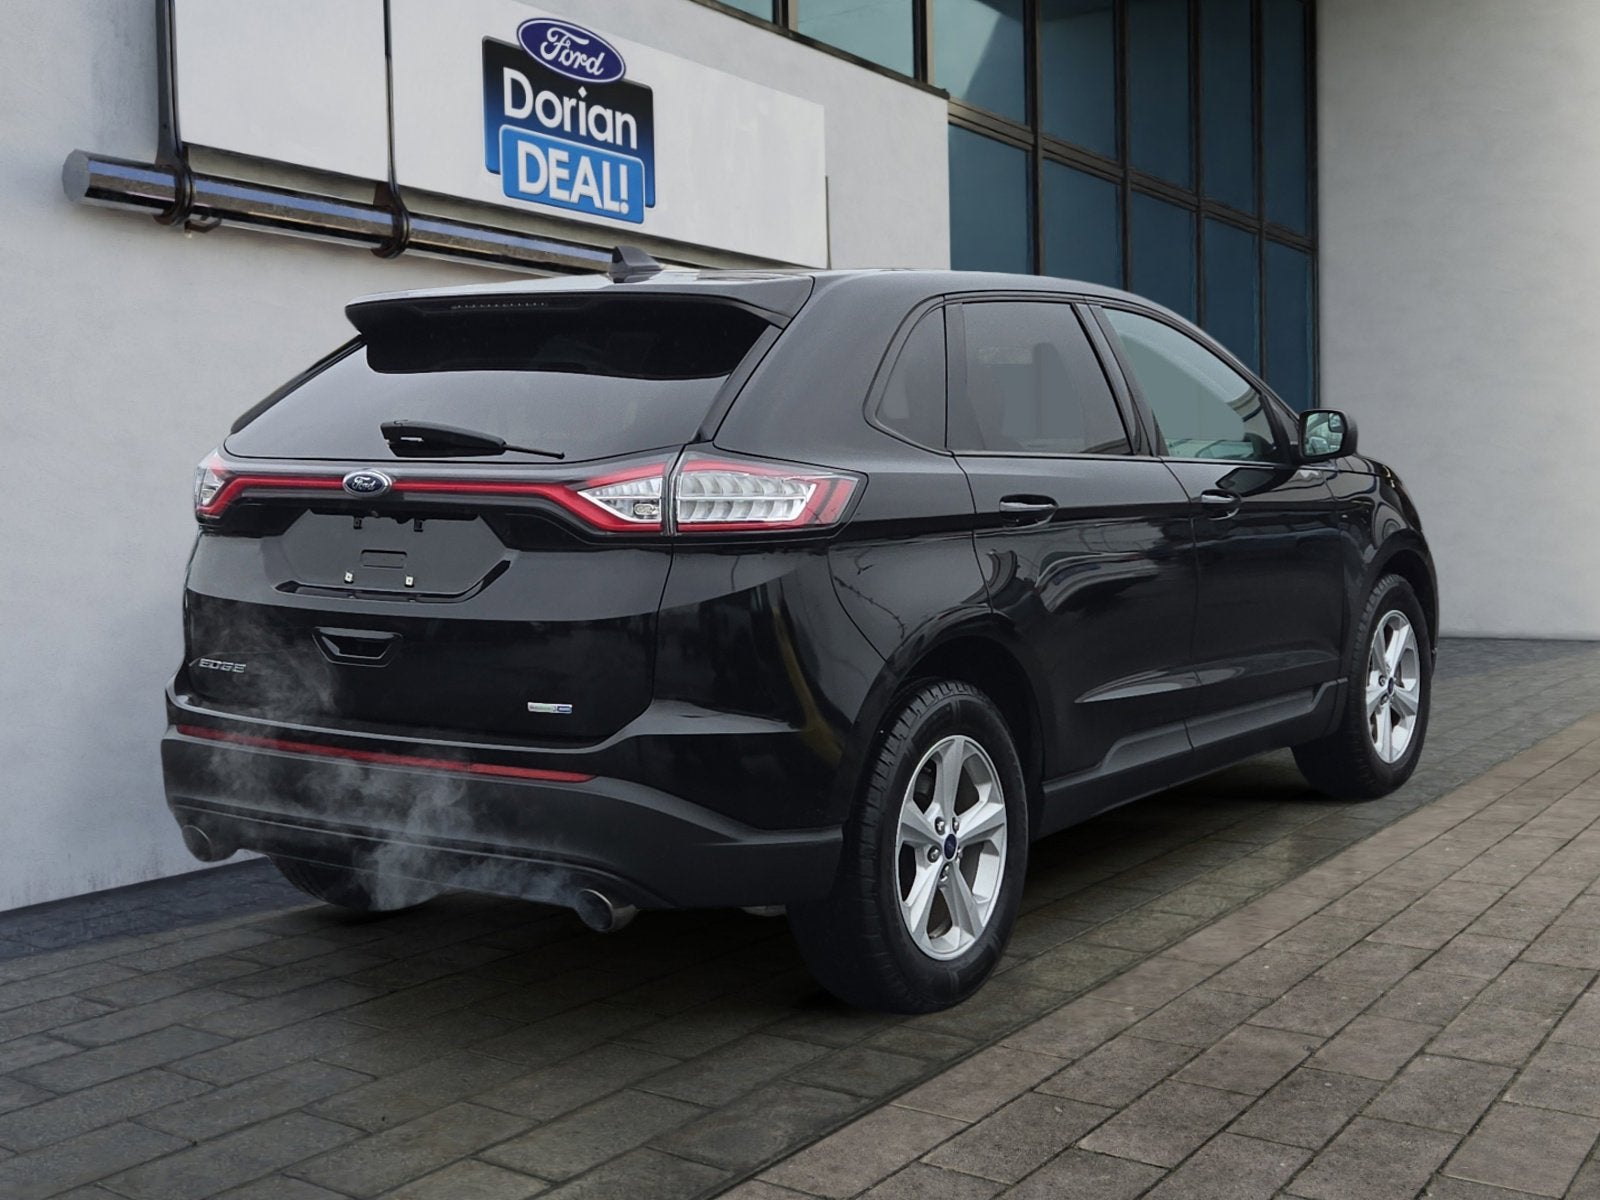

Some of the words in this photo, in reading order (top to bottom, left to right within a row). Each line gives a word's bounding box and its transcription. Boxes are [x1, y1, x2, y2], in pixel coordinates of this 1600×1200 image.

[540, 27, 605, 76] Ford
[503, 66, 637, 150] Dorian
[517, 139, 630, 214] DEAL!
[352, 476, 376, 490] Ford
[199, 658, 247, 673] EDGE
